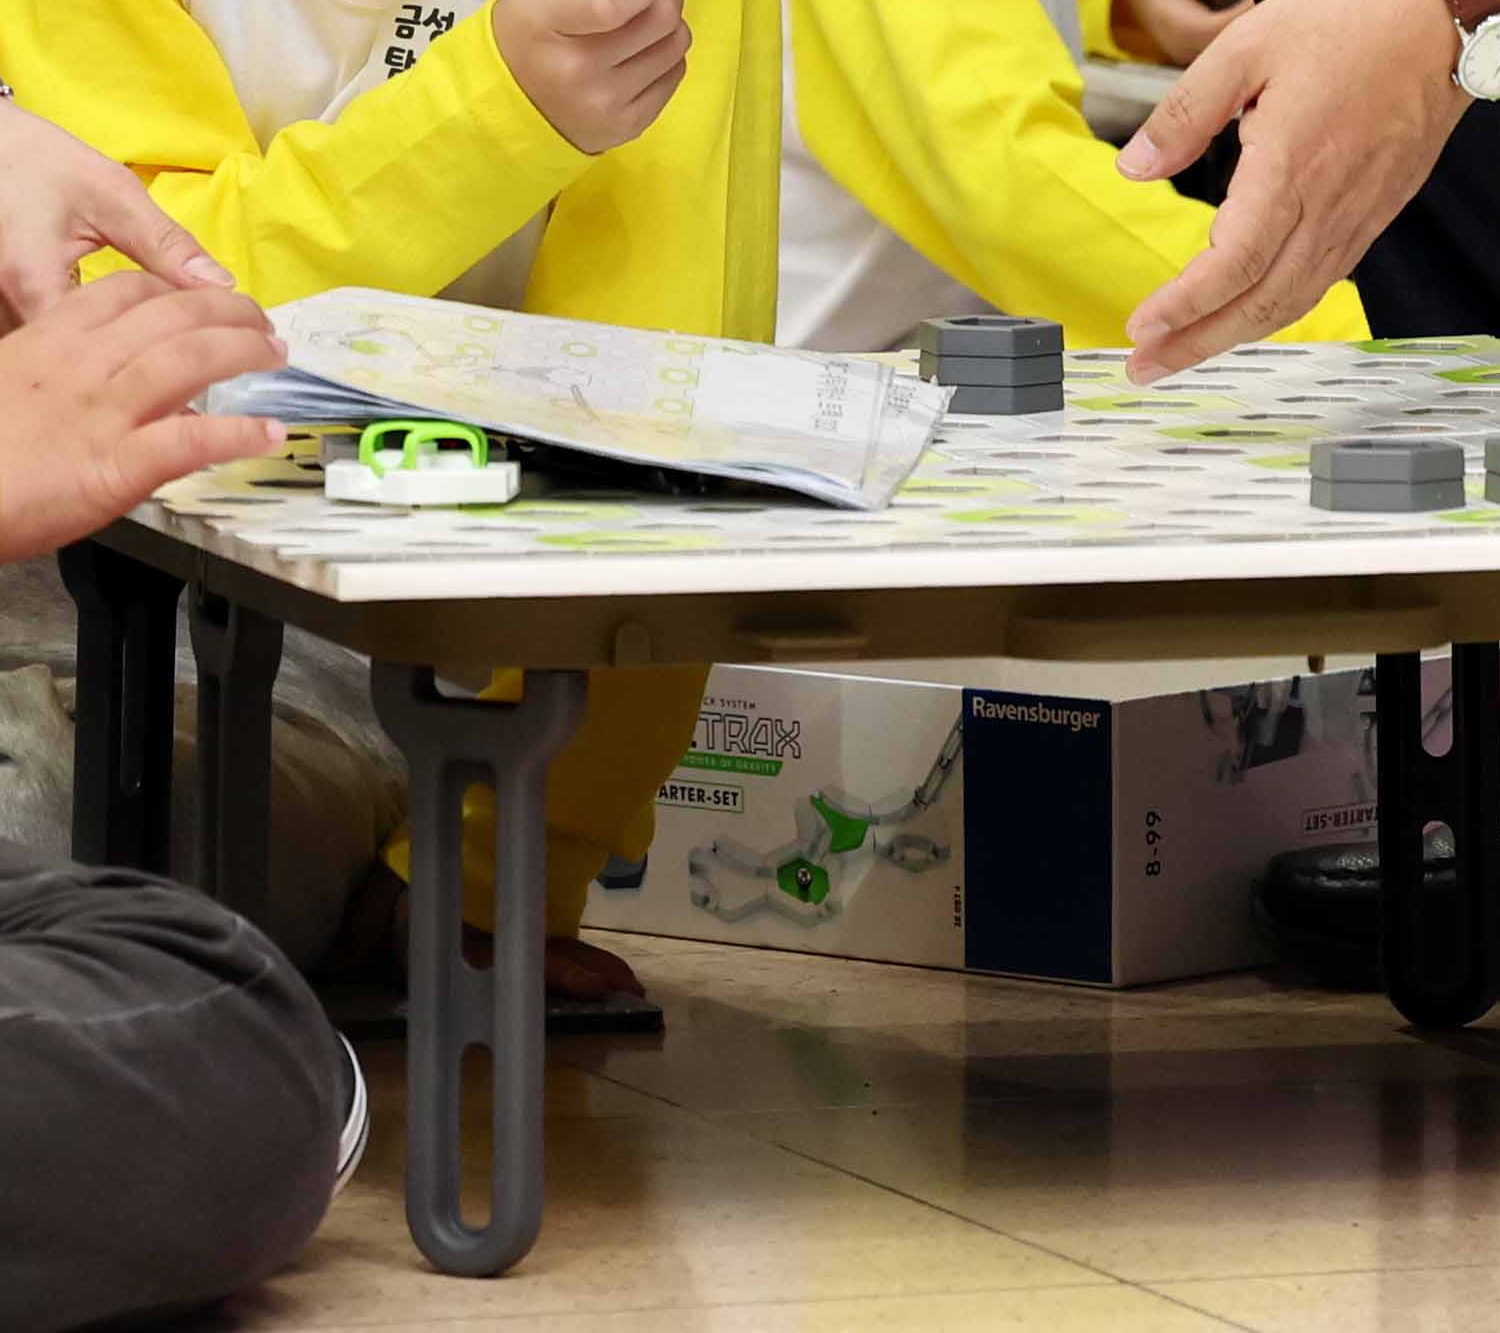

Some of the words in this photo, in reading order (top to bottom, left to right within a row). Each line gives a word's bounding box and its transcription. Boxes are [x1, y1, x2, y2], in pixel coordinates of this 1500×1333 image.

[395, 5, 455, 42] 금성
[720, 698, 756, 710] SYSTEM
[972, 696, 1101, 732] Ravensburger
[691, 710, 802, 759] TRAX
[656, 785, 739, 807] ARTER-SET
[1145, 811, 1162, 877] 8-99
